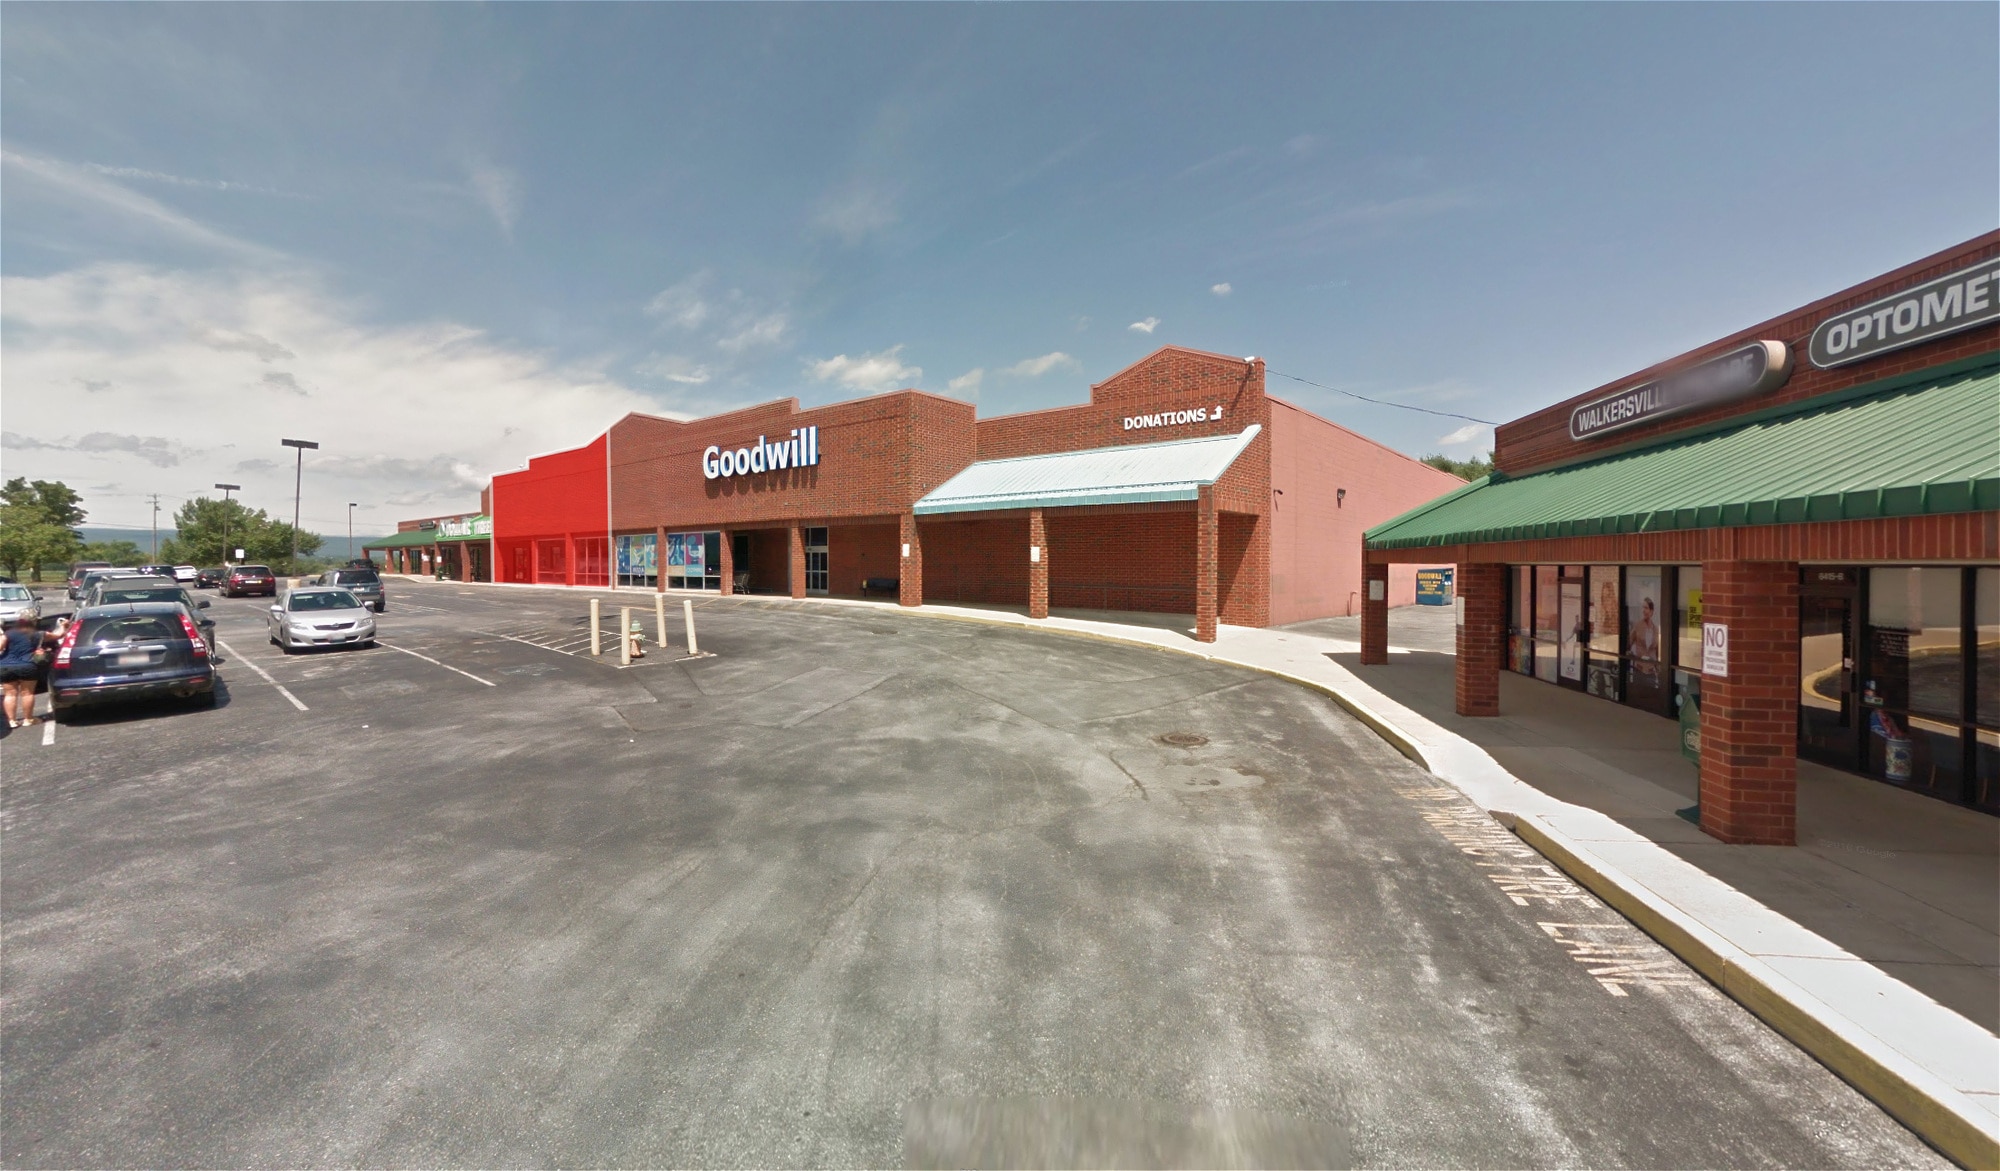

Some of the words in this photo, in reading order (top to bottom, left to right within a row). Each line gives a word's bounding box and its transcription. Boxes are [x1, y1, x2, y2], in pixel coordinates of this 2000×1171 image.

[1124, 408, 1206, 430] DONATIONS
[1578, 385, 1666, 432] WALKERSVILL
[703, 425, 818, 479] Goodwill
[1706, 628, 1725, 648] NO
[1475, 862, 1602, 908] FIRE
[1536, 921, 1722, 1000] LANE
